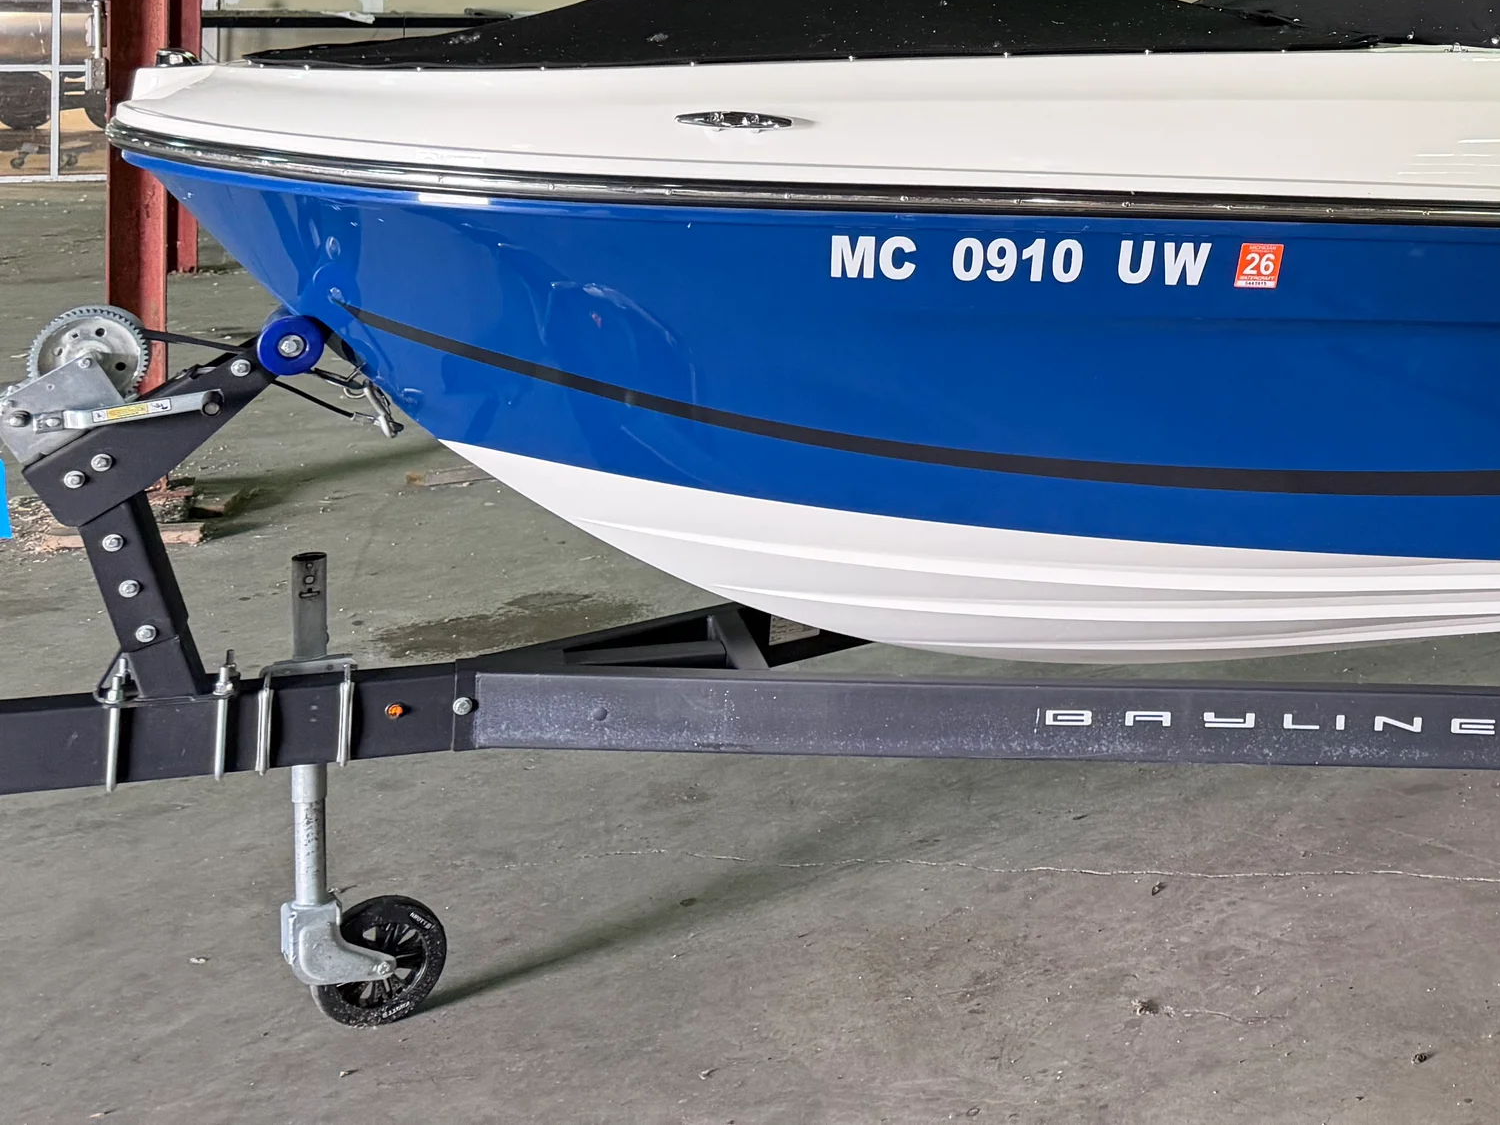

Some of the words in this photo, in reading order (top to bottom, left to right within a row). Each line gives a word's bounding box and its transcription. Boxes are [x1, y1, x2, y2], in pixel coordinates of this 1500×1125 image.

[830, 235, 917, 280] MC
[952, 237, 1083, 283] 0910
[1118, 240, 1212, 286] UW
[1242, 252, 1276, 276] 26
